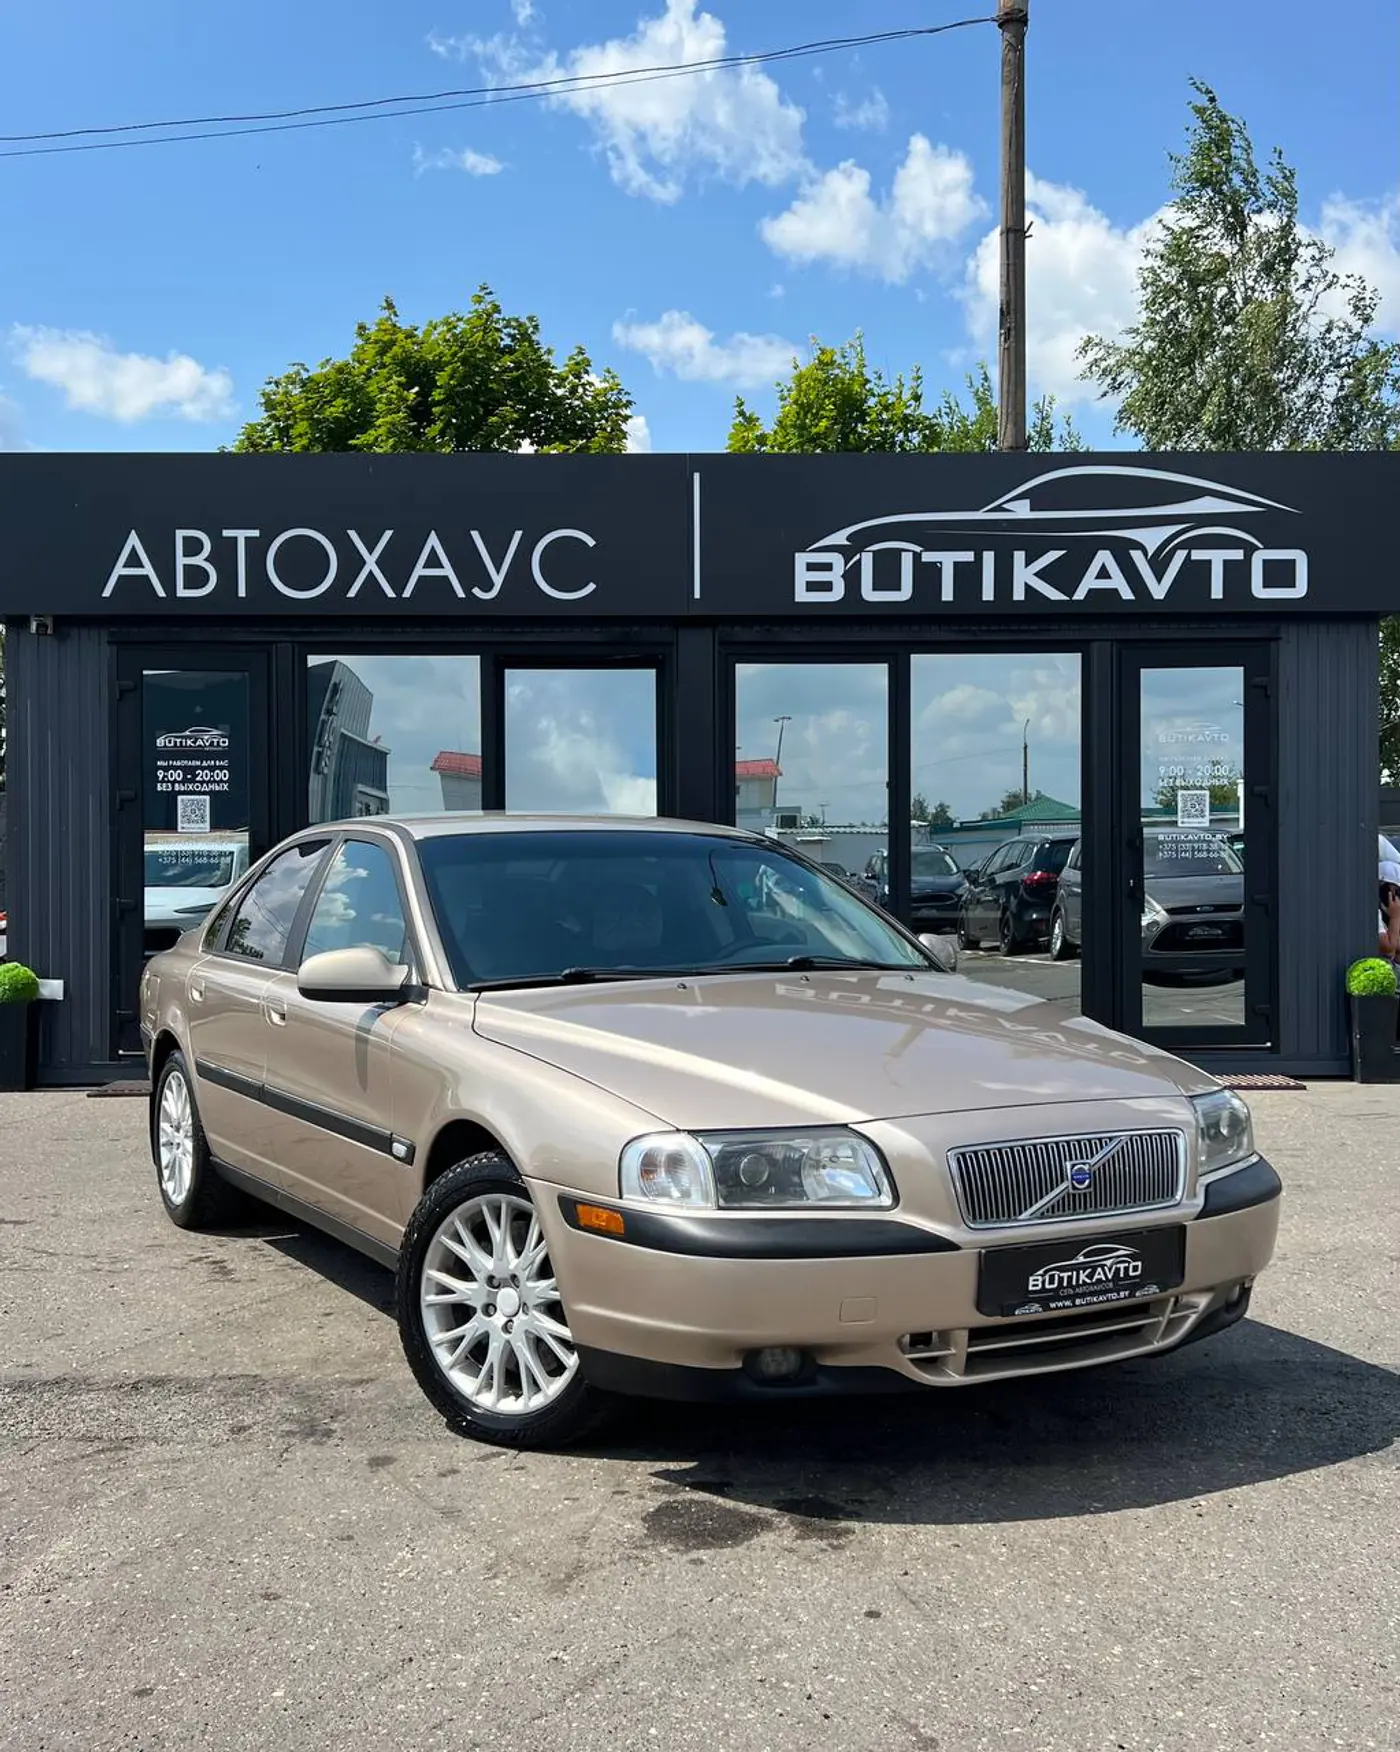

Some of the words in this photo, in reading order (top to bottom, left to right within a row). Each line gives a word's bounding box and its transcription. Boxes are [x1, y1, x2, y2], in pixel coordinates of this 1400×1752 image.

[101, 528, 598, 601] АВТОХАУС
[793, 547, 1309, 604] BUTIKAVTO
[156, 738, 229, 747] BUTIKAVTO
[157, 769, 183, 781] 9:00
[195, 769, 229, 781] 20:00
[157, 783, 172, 791] БЕЗ
[174, 783, 229, 792] ВЫХОДНЫХ
[1028, 1260, 1143, 1291] BUTIKAVTO
[1075, 1290, 1131, 1305] BUTIKAVTO.BY
